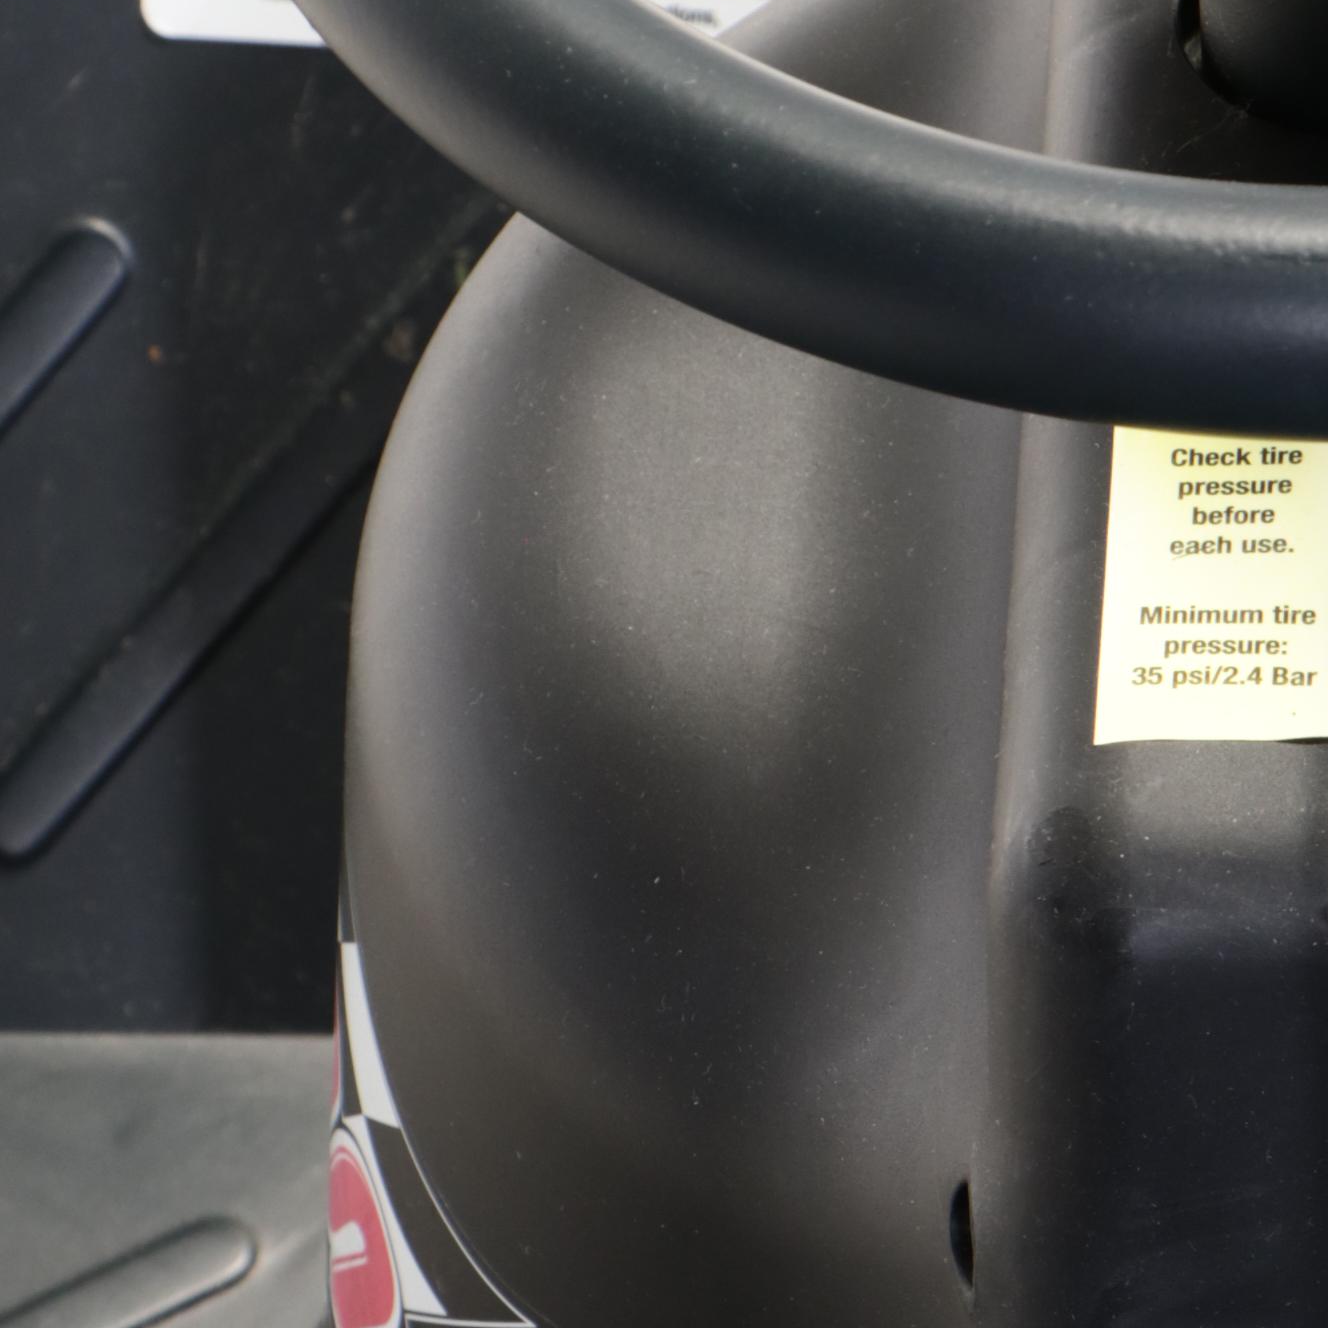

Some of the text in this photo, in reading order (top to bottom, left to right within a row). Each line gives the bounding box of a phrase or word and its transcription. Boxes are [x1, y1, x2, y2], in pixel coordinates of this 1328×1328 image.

[1170, 446, 1304, 467] Check tire
[1177, 479, 1293, 500] pressure
[1191, 506, 1276, 525] before
[1169, 536, 1295, 555] each use.
[1139, 605, 1317, 625] Minimum tire
[1163, 638, 1288, 658] pressure:
[1131, 665, 1318, 689] 35 psi/2.4 Bar
